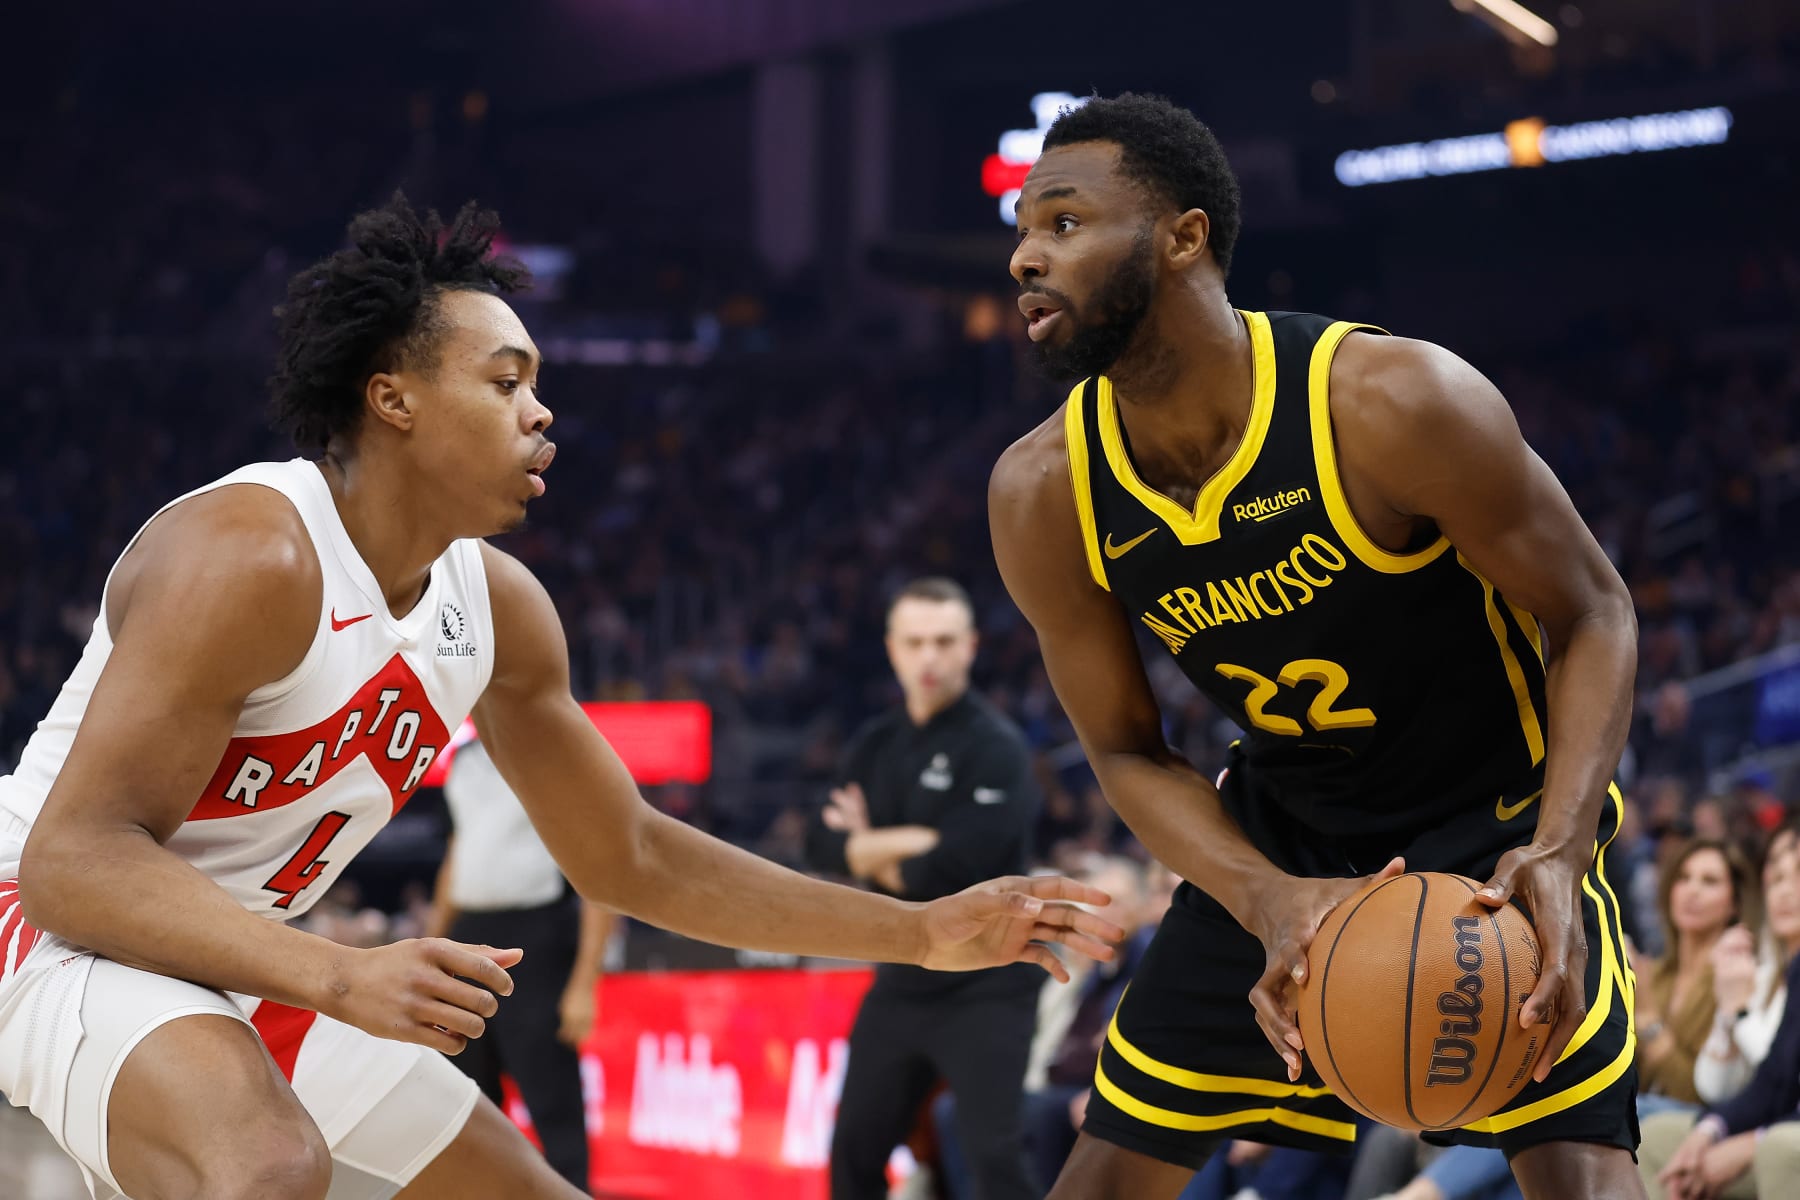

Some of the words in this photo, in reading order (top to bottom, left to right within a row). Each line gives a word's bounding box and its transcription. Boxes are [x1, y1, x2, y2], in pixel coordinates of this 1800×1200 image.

[1232, 487, 1312, 522] Rakuten
[1157, 533, 1347, 634] FRANCISCO
[455, 642, 477, 657] Life
[1141, 611, 1191, 655] AN
[1215, 659, 1377, 736] 22
[261, 810, 352, 910] 4
[1425, 915, 1484, 1088] Wilson
